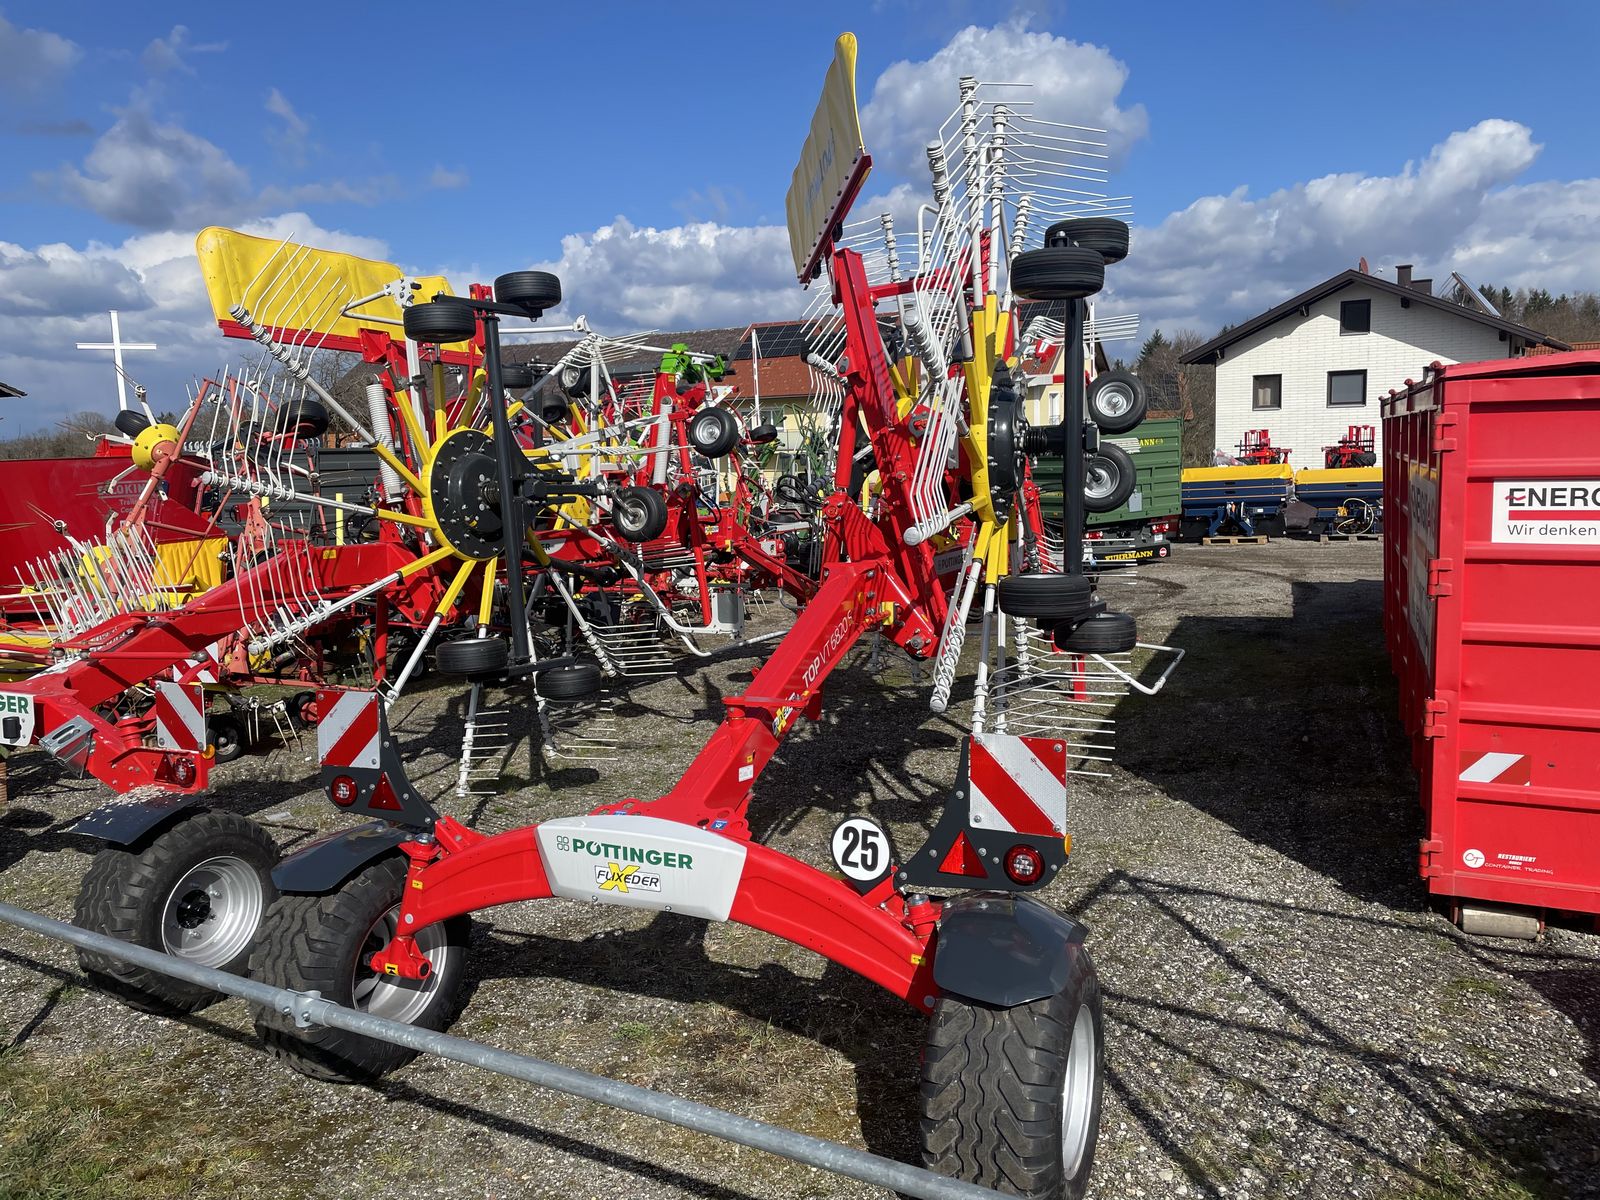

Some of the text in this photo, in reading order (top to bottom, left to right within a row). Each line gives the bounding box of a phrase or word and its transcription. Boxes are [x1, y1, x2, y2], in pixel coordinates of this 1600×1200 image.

[1507, 524, 1597, 536] Wir denken
[802, 656, 820, 689] TOP
[819, 640, 831, 665] VT
[830, 616, 849, 651] 6820
[841, 825, 880, 872] 25
[1497, 853, 1537, 862] RESTAURIERT
[1484, 862, 1554, 876] CONTAINER TRADING
